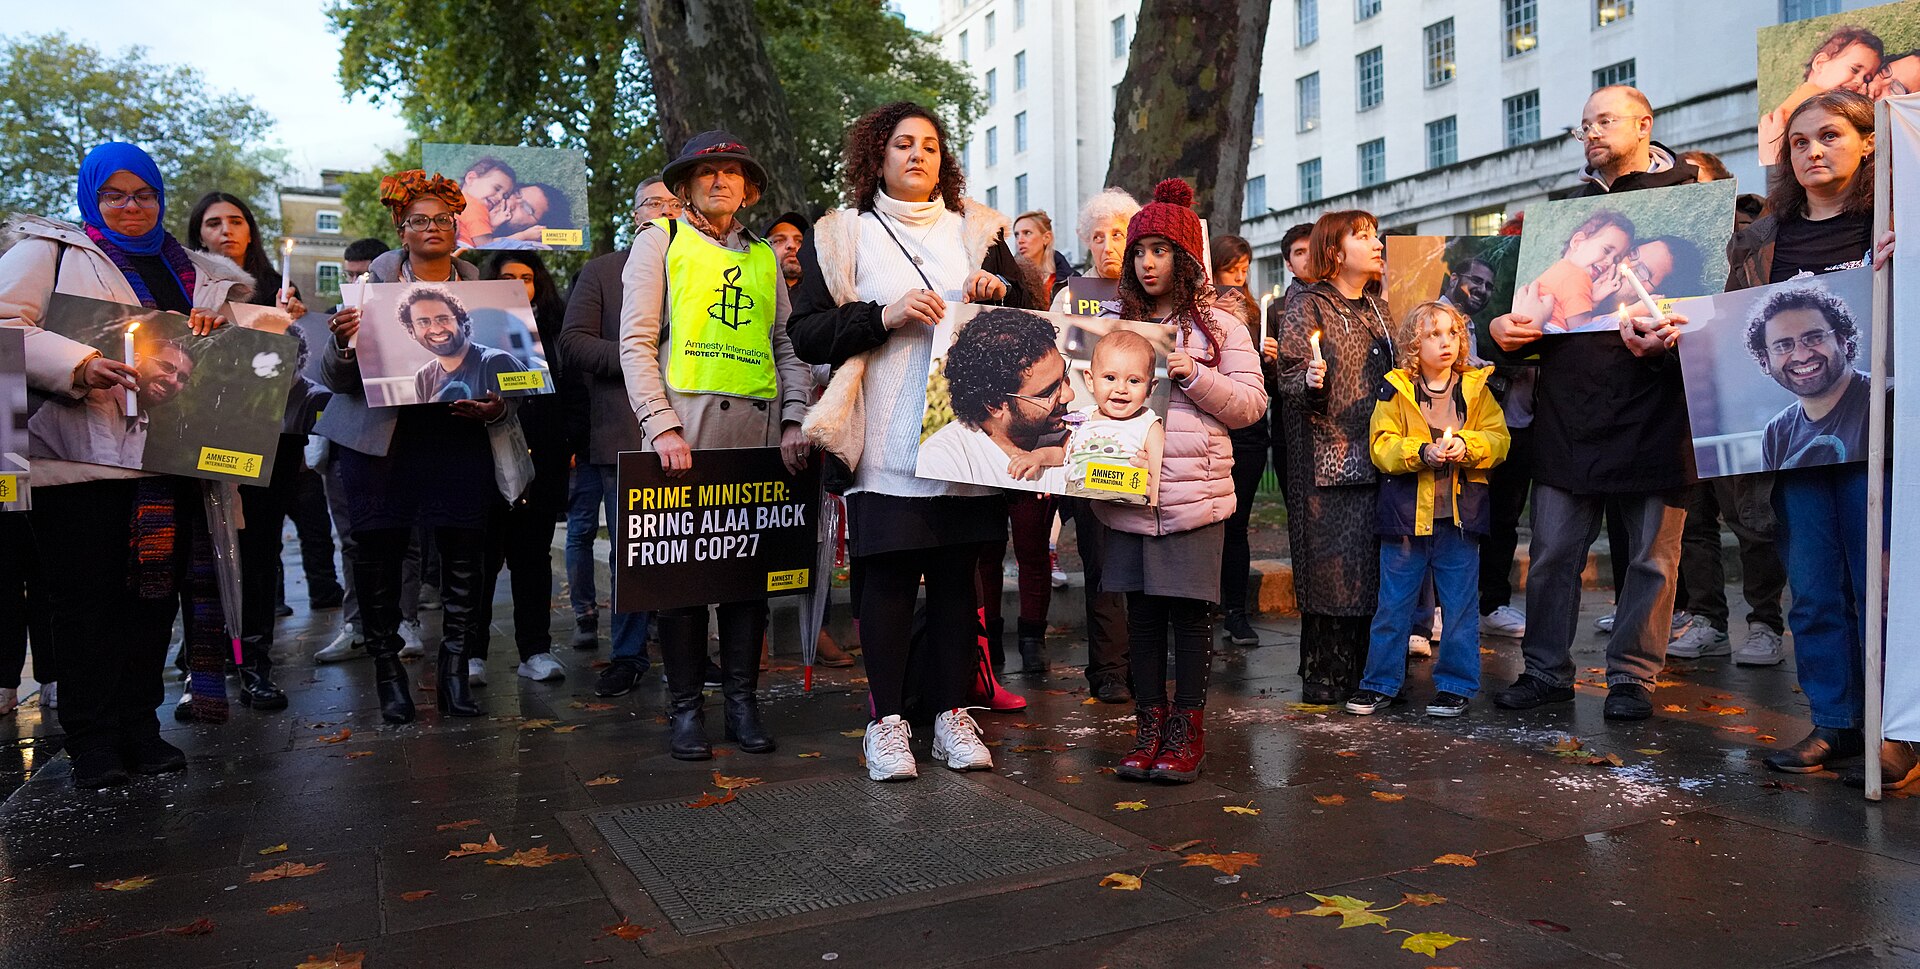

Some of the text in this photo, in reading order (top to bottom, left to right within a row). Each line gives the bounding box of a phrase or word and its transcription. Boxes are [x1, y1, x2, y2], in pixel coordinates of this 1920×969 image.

[685, 339, 770, 360] Amnesty Internationa
[684, 350, 761, 365] PROTECT THE HUMAN
[204, 460, 237, 470] INTERNATIONAL
[205, 453, 239, 464] AMNESTY
[1091, 468, 1125, 480] AMNESTY
[1090, 477, 1124, 487] INTERNATIONAL
[628, 481, 790, 511] PRIME MINISTER:
[628, 503, 806, 539] BRING ALAA BACK
[627, 533, 760, 567] FROM COP27
[771, 574, 794, 582] AMNESTY
